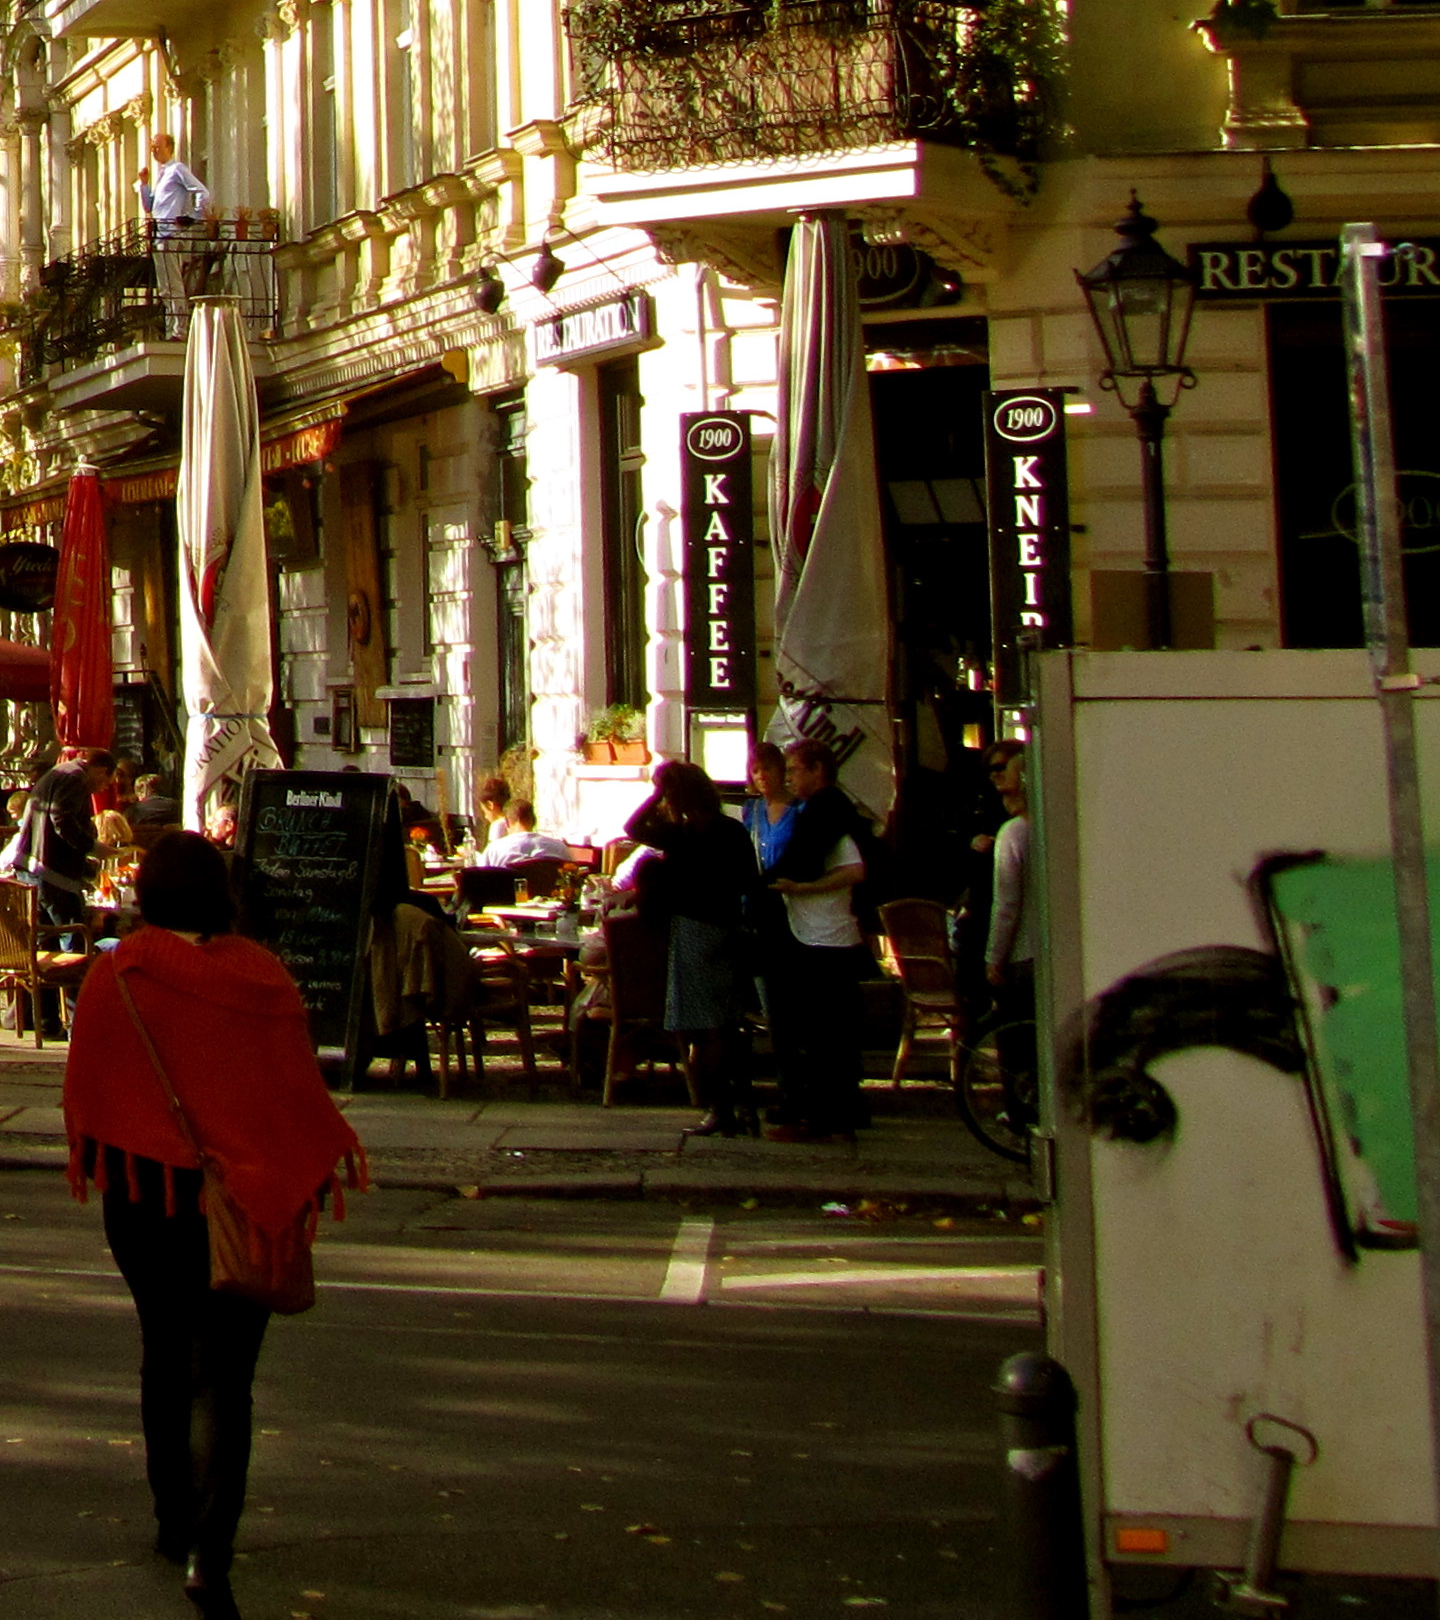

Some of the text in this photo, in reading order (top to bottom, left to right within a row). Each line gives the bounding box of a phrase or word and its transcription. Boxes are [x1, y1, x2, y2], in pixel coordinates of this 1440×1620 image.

[1197, 246, 1440, 290] RESTUR
[535, 296, 640, 361] RESTAURATION
[698, 427, 733, 451] 1900
[1006, 405, 1045, 430] 1900
[702, 473, 731, 689] KAFFEE
